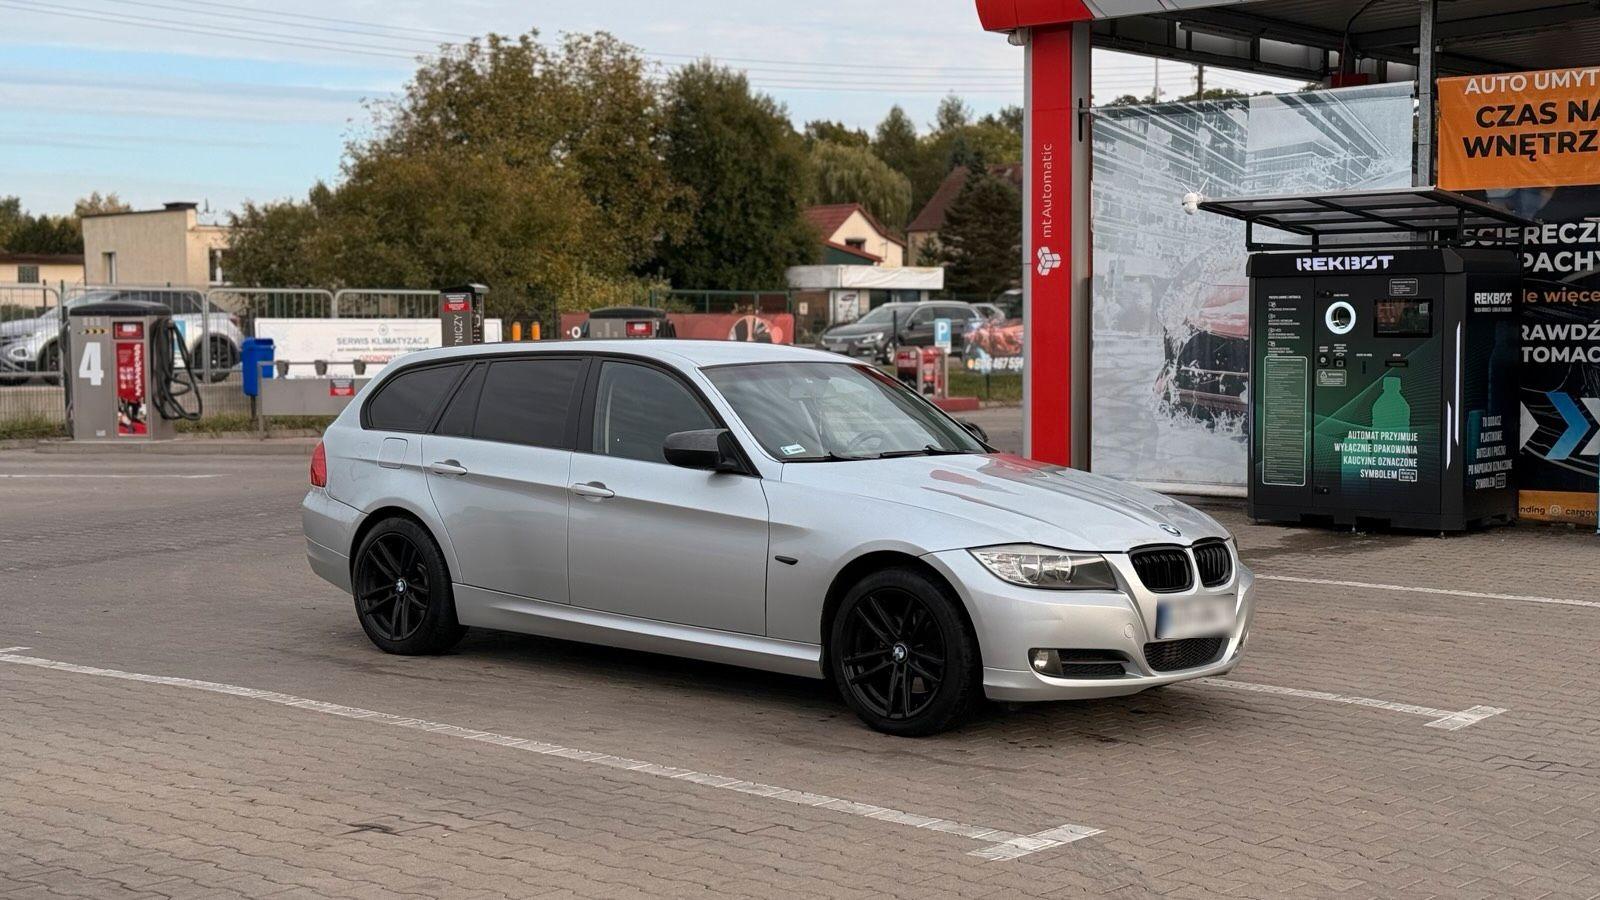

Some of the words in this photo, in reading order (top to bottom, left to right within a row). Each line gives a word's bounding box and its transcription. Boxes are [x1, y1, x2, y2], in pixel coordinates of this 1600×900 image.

[1464, 74, 1527, 95] AUTO
[1475, 102, 1558, 128] CZAS
[1041, 143, 1053, 238] mtAutomatic
[1296, 255, 1394, 271] REKBOT
[336, 337, 369, 345] SERWIS
[371, 336, 430, 345] KLIMATYZACJI
[79, 342, 104, 385] 4
[1348, 430, 1379, 440] AUTOMAT
[1380, 431, 1418, 442] PRZYJMUJE
[1334, 443, 1372, 454] WYŁĄCZNIE
[1373, 444, 1418, 455] OPAKOWANIA
[1343, 456, 1376, 466] KAUCYJNE
[1377, 457, 1418, 468] OZNACZONE
[1360, 469, 1398, 480] SYMBOLEM
